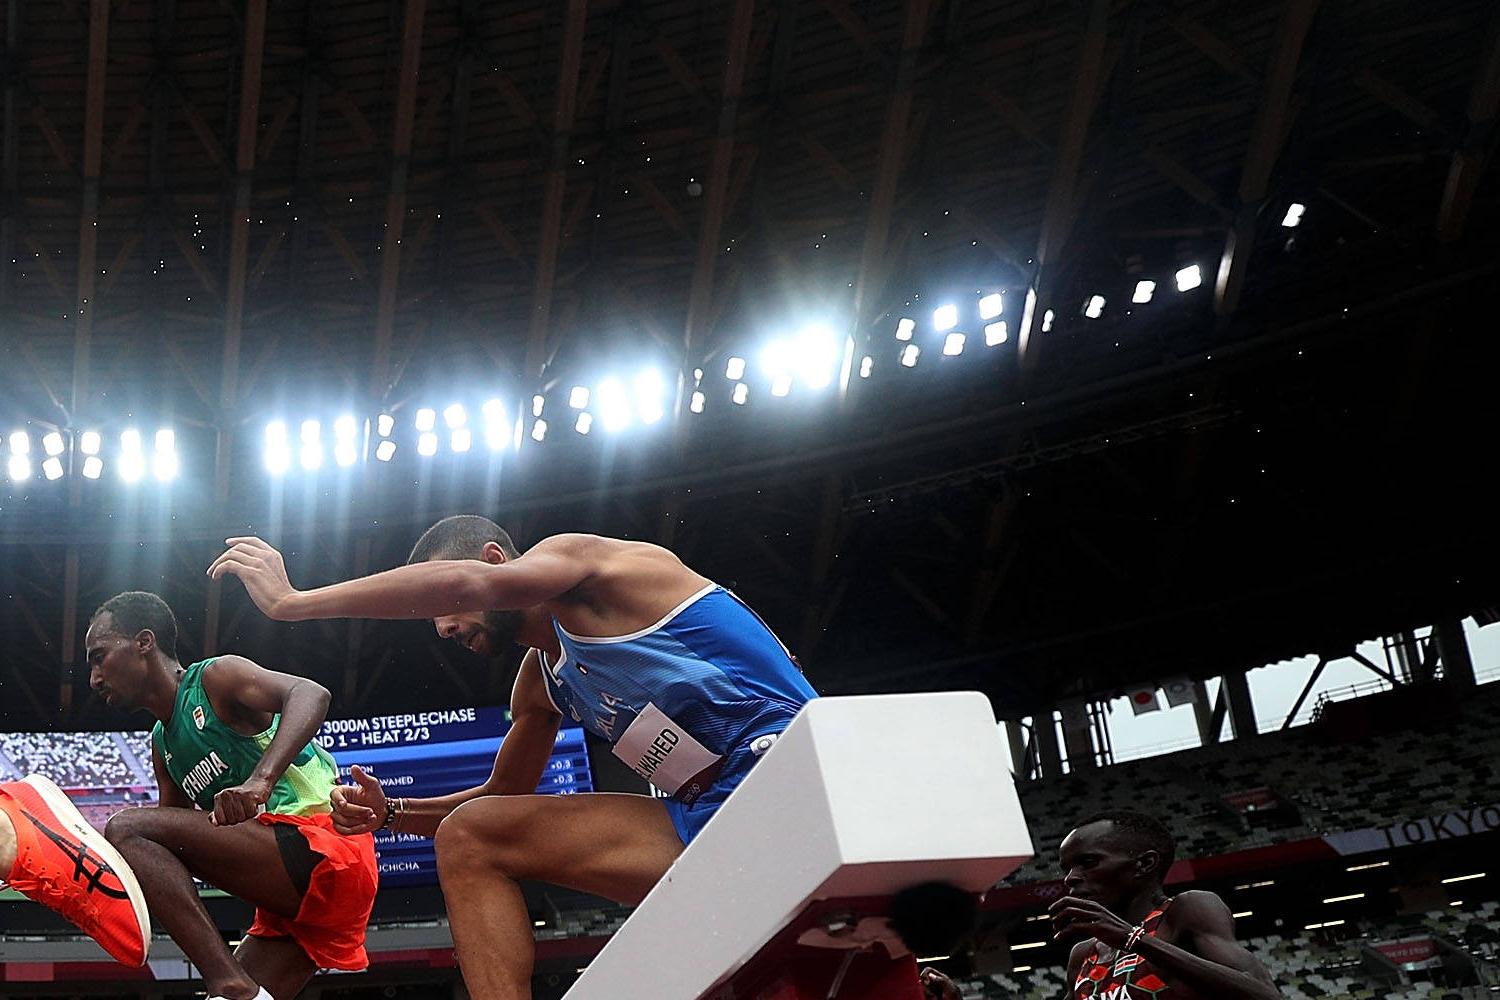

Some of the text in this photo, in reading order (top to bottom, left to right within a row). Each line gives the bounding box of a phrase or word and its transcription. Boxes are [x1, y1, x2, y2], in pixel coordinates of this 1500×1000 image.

[323, 708, 476, 734] 3000M STEEPLECHASE
[338, 735, 348, 747] 1
[362, 730, 401, 745] HEAT
[409, 727, 430, 742] 2/3
[182, 751, 229, 801] ETHIOPIA
[1376, 807, 1500, 850] TOKYO
